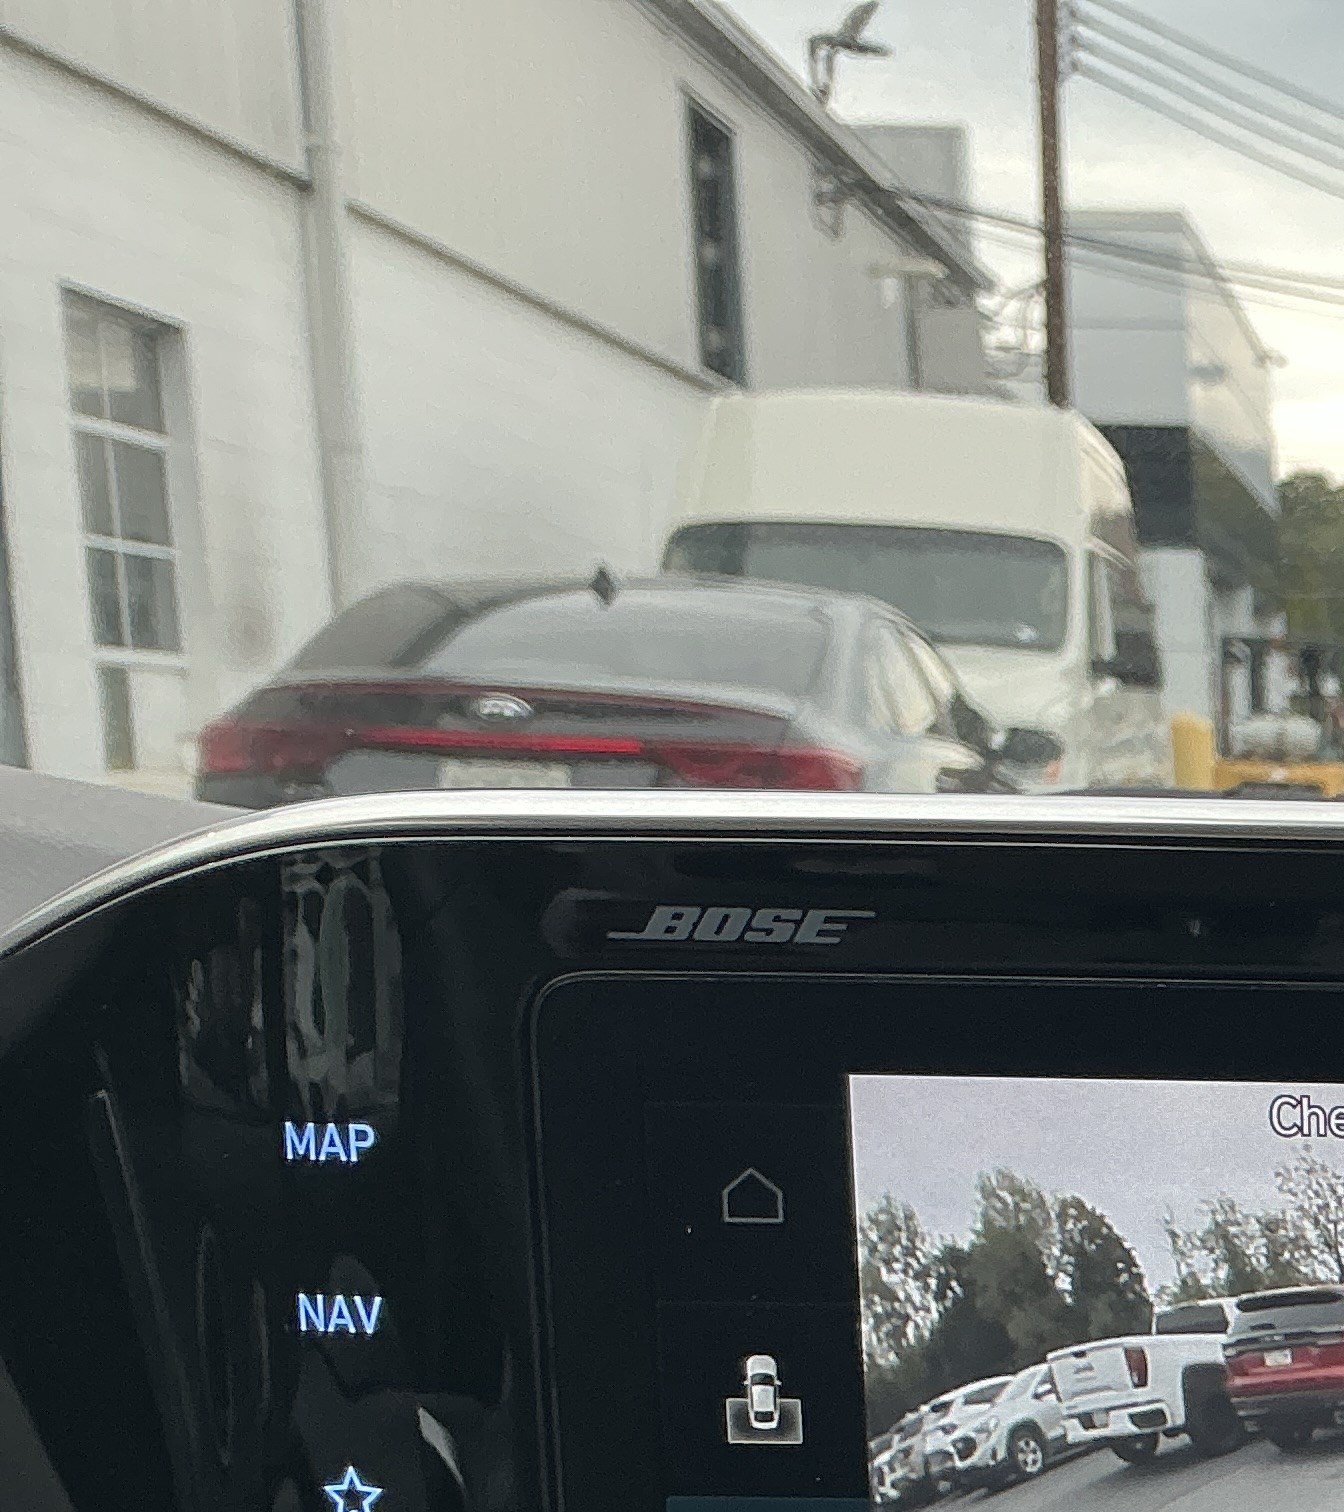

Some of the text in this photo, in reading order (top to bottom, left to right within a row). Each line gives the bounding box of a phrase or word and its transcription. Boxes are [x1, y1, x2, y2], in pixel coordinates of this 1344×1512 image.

[606, 905, 877, 944] BOSE
[283, 1120, 376, 1163] MAP
[297, 1292, 383, 1336] NAV
